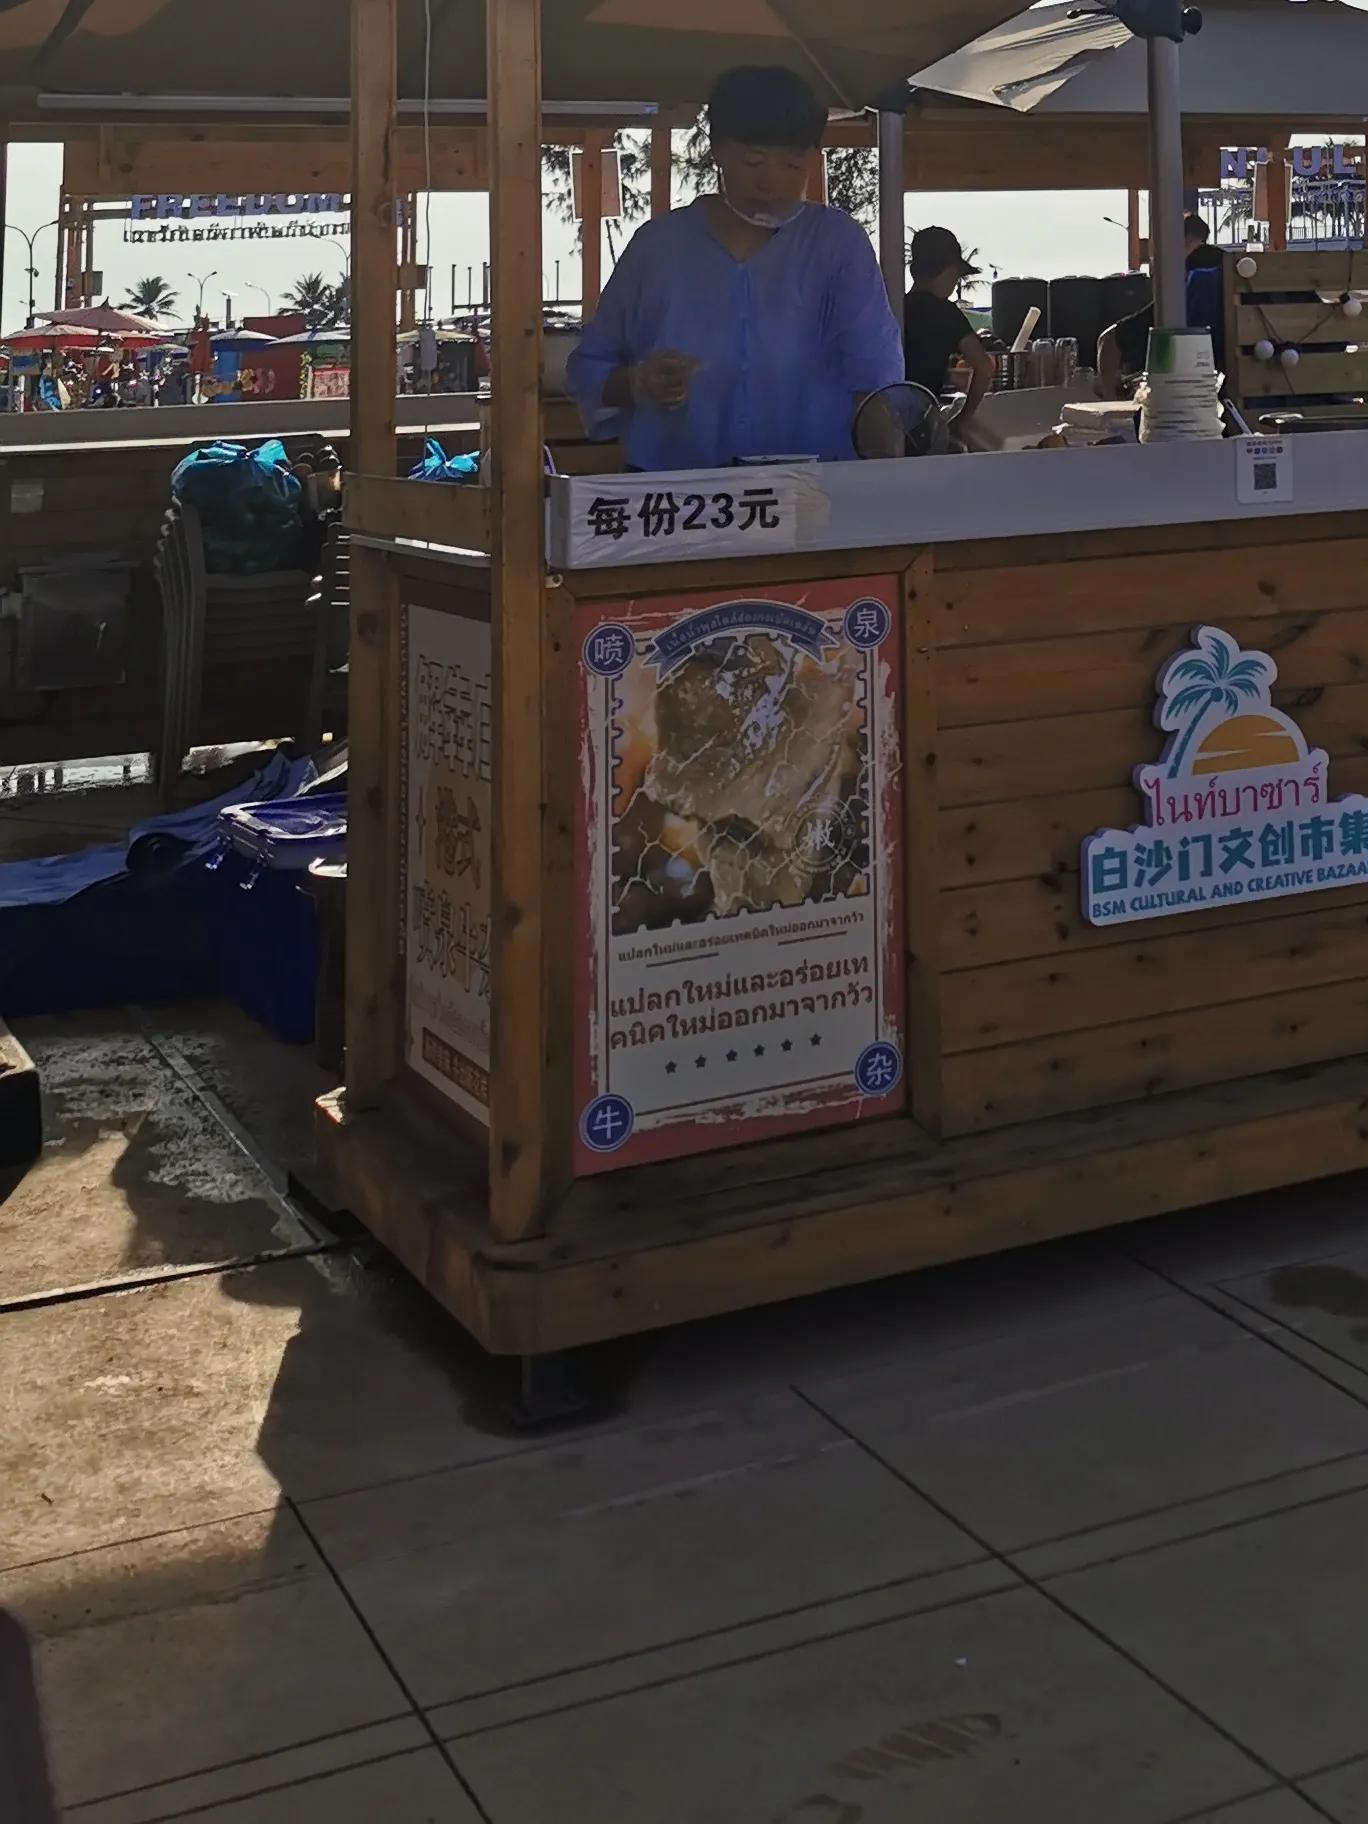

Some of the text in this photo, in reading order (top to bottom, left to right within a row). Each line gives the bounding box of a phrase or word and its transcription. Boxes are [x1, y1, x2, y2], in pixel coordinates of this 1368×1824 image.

[131, 193, 341, 220] FREEDOM
[586, 488, 780, 541] 每份23元
[854, 607, 881, 639] 泉
[593, 632, 625, 666] 喷
[1144, 761, 1321, 827] ไนท์บาซาร์
[1092, 900, 1127, 919] BSM
[1130, 886, 1208, 911] CULTURAL
[1210, 880, 1244, 899] AND
[1247, 869, 1315, 893] CREATIVE
[610, 955, 870, 1018] แปลกใหม่และอร่อยเท
[610, 981, 873, 1050] คนิคใหม่ออกมาจากวัว
[865, 1053, 894, 1087] 杂
[591, 1104, 623, 1140] 牛
